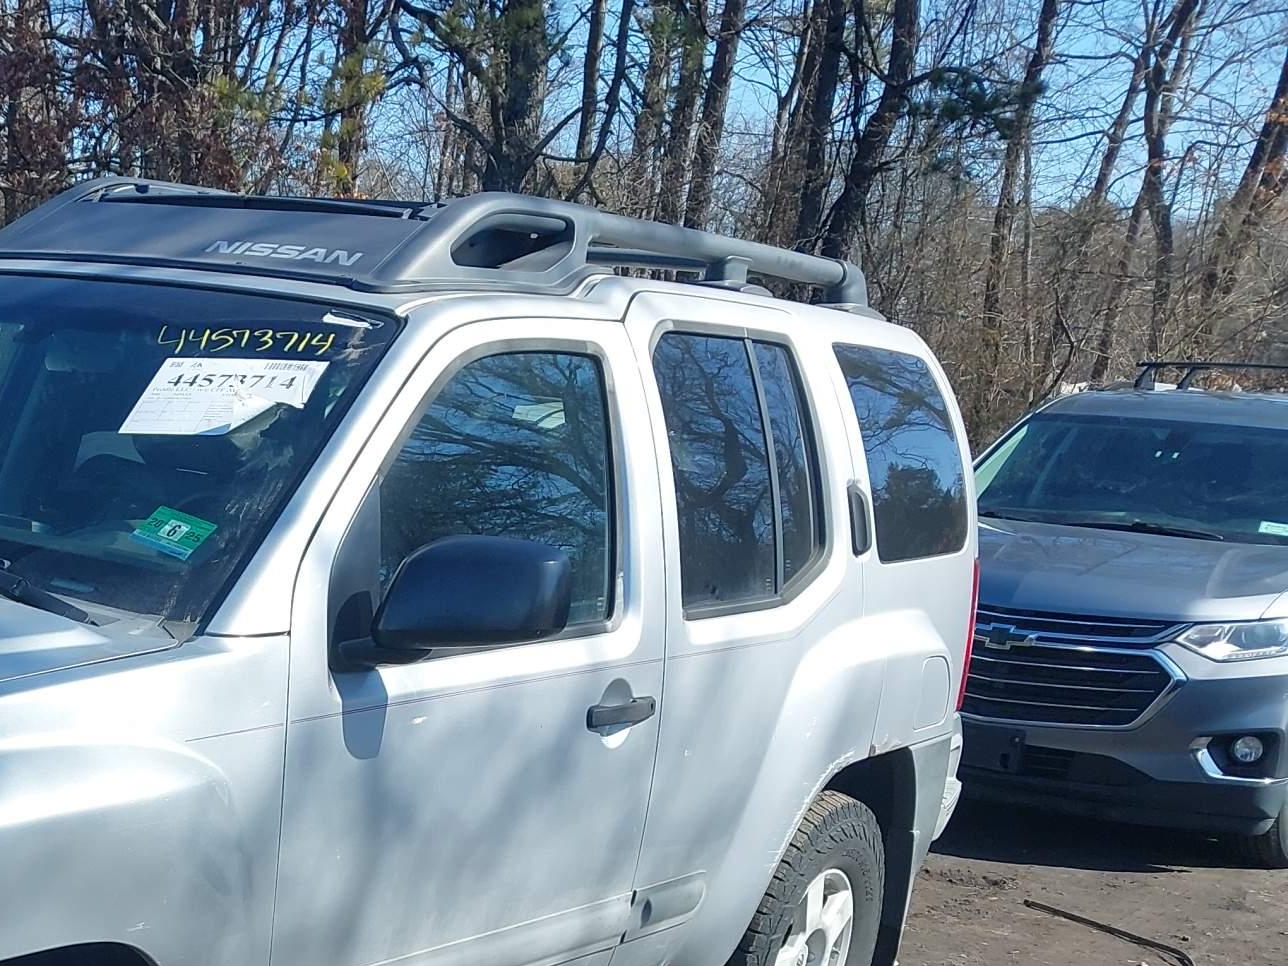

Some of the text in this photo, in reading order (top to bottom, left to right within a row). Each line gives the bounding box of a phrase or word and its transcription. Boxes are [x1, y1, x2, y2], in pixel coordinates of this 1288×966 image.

[205, 240, 364, 266] NISSAN
[157, 325, 335, 355] 44573714
[167, 373, 298, 390] 44573714
[166, 524, 182, 537] 6
